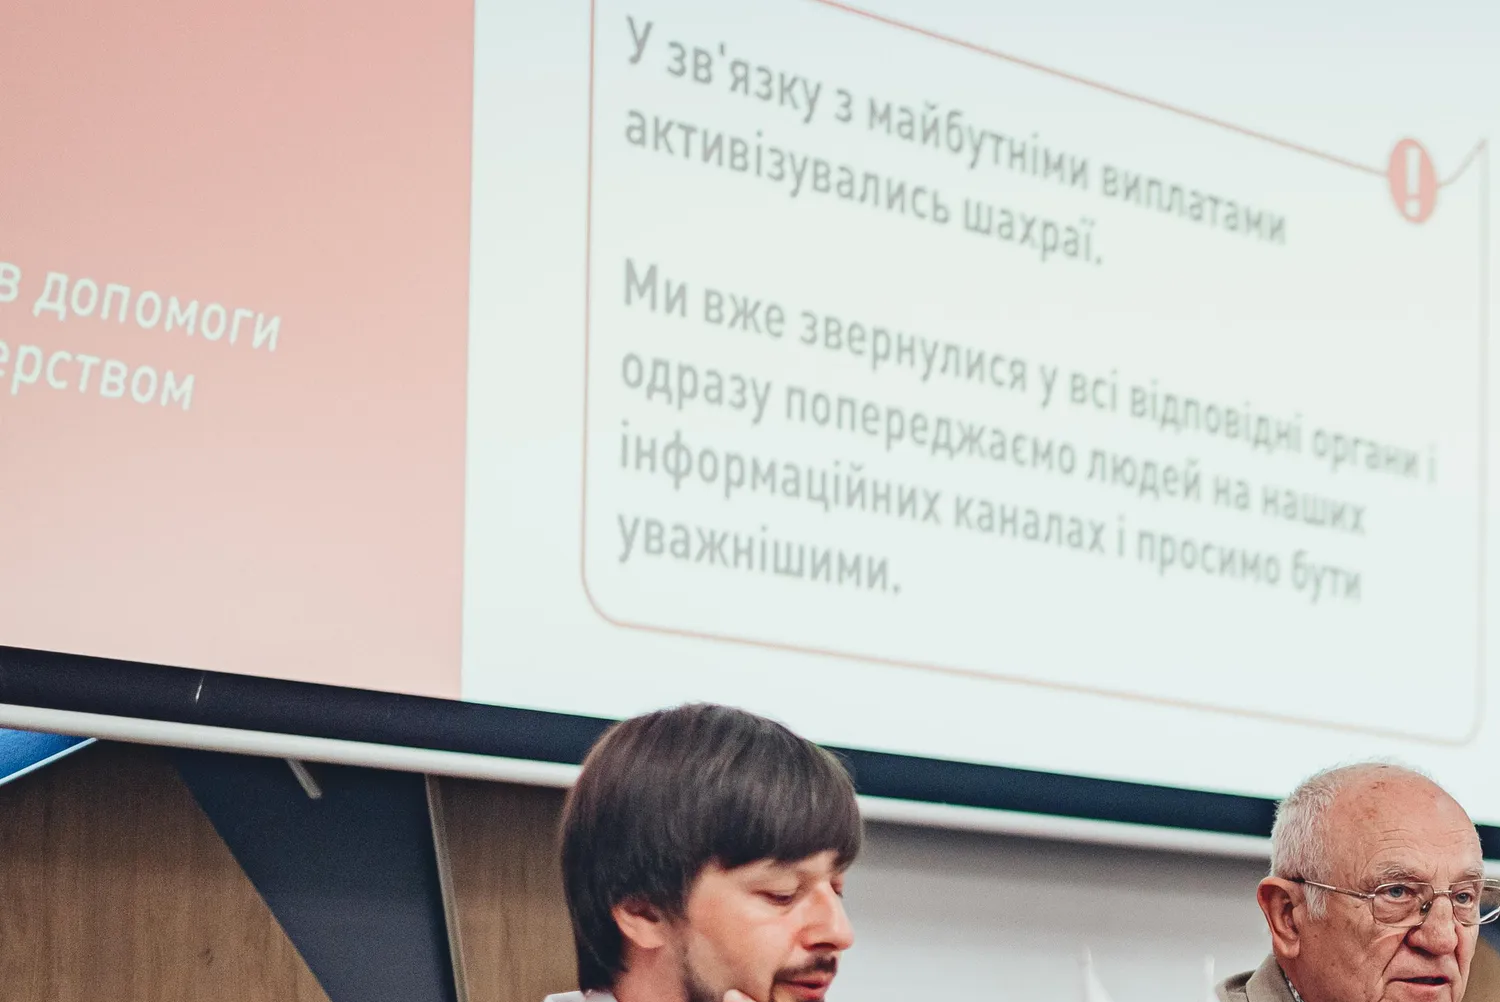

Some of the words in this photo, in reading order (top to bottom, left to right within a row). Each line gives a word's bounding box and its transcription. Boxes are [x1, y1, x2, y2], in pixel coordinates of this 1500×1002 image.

[625, 109, 951, 225] активізувались
[963, 198, 1102, 265] шахраї.
[626, 15, 654, 65] У
[666, 40, 822, 125] зв'язку
[834, 88, 853, 124] з
[868, 97, 1088, 190] майбутніми
[1102, 164, 1285, 243] виплатами
[32, 271, 282, 352] допомоги
[624, 257, 687, 318] Ми
[704, 288, 785, 339] вже
[800, 310, 1027, 392] звернулися
[1039, 365, 1058, 409] у
[1070, 370, 1119, 411] всі
[1130, 379, 1302, 453] відповідні
[1313, 428, 1418, 477] органи
[621, 419, 941, 524] інформаційних
[954, 495, 1105, 553] каналах
[1116, 510, 1126, 557] і
[1137, 530, 1280, 585] просимо
[1292, 549, 1360, 603] бути
[622, 352, 772, 426] одразу
[786, 385, 1076, 475] попереджаємо
[1087, 448, 1200, 500] людей
[1214, 476, 1250, 511] на
[1262, 487, 1364, 533] наших
[617, 514, 901, 594] уважнішими.
